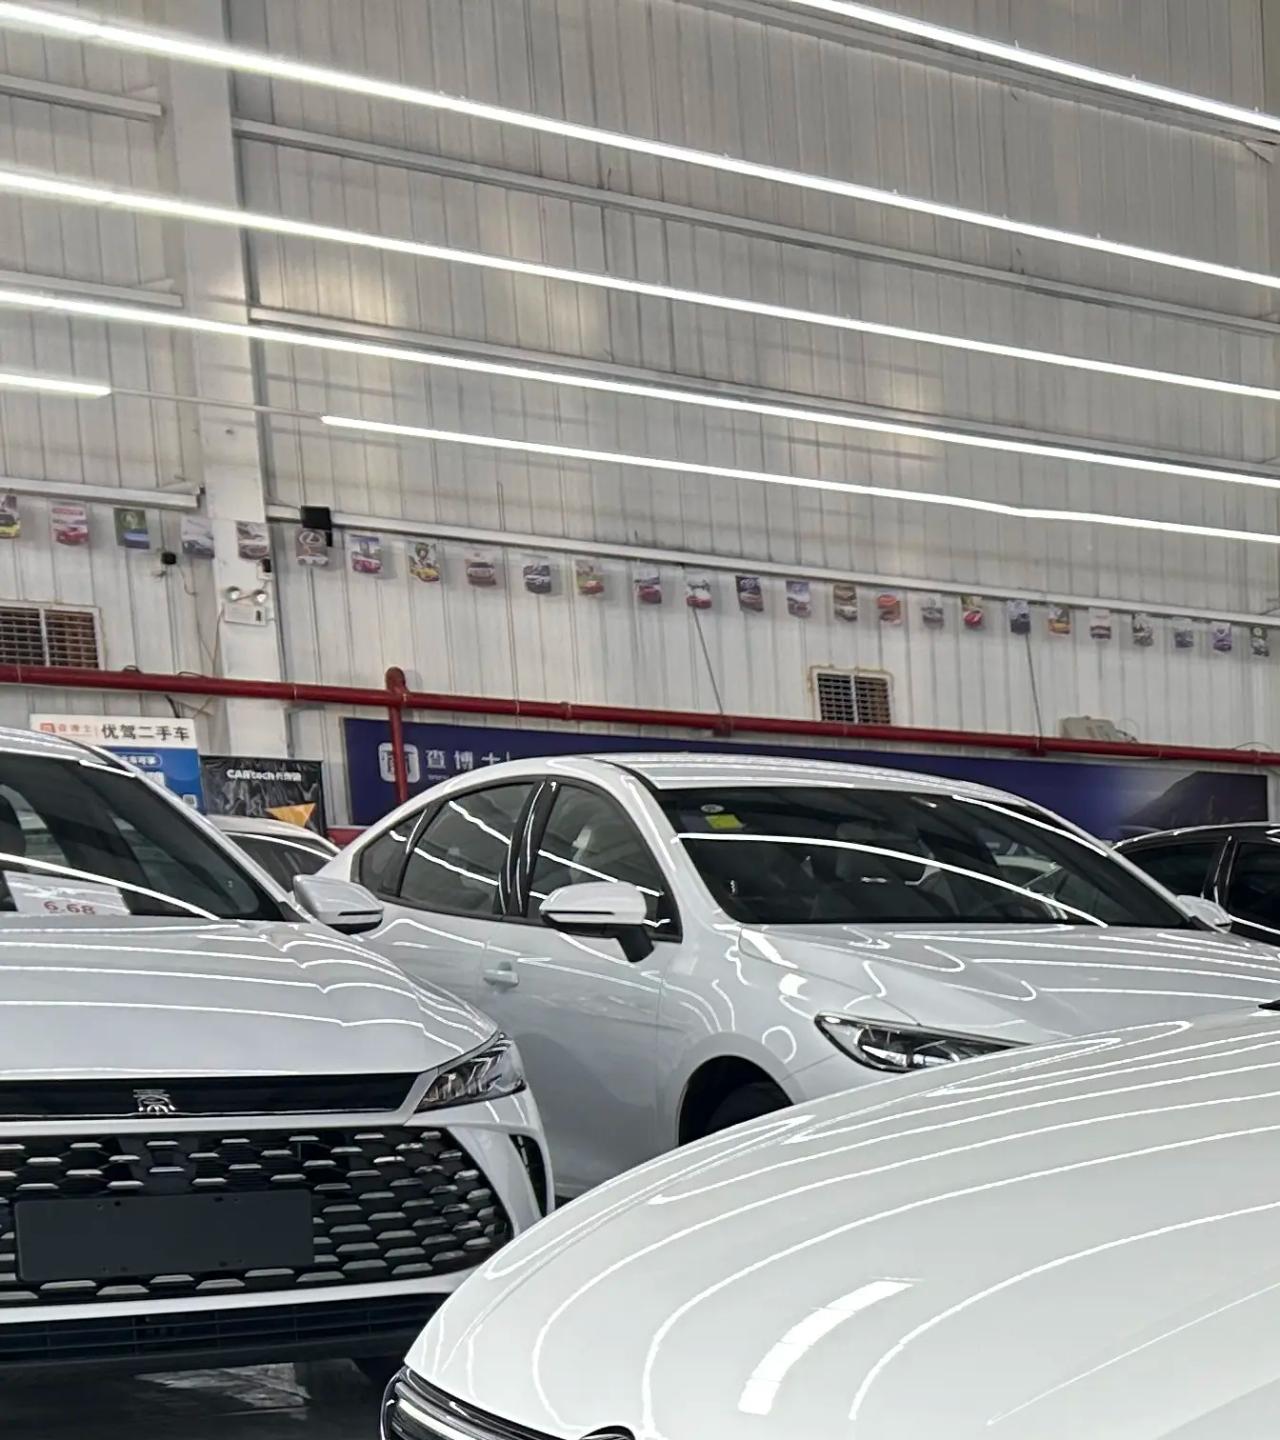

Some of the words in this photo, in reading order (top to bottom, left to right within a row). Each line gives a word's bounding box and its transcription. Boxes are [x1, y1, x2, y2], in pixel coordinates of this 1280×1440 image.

[101, 723, 190, 741] 优驾二手车
